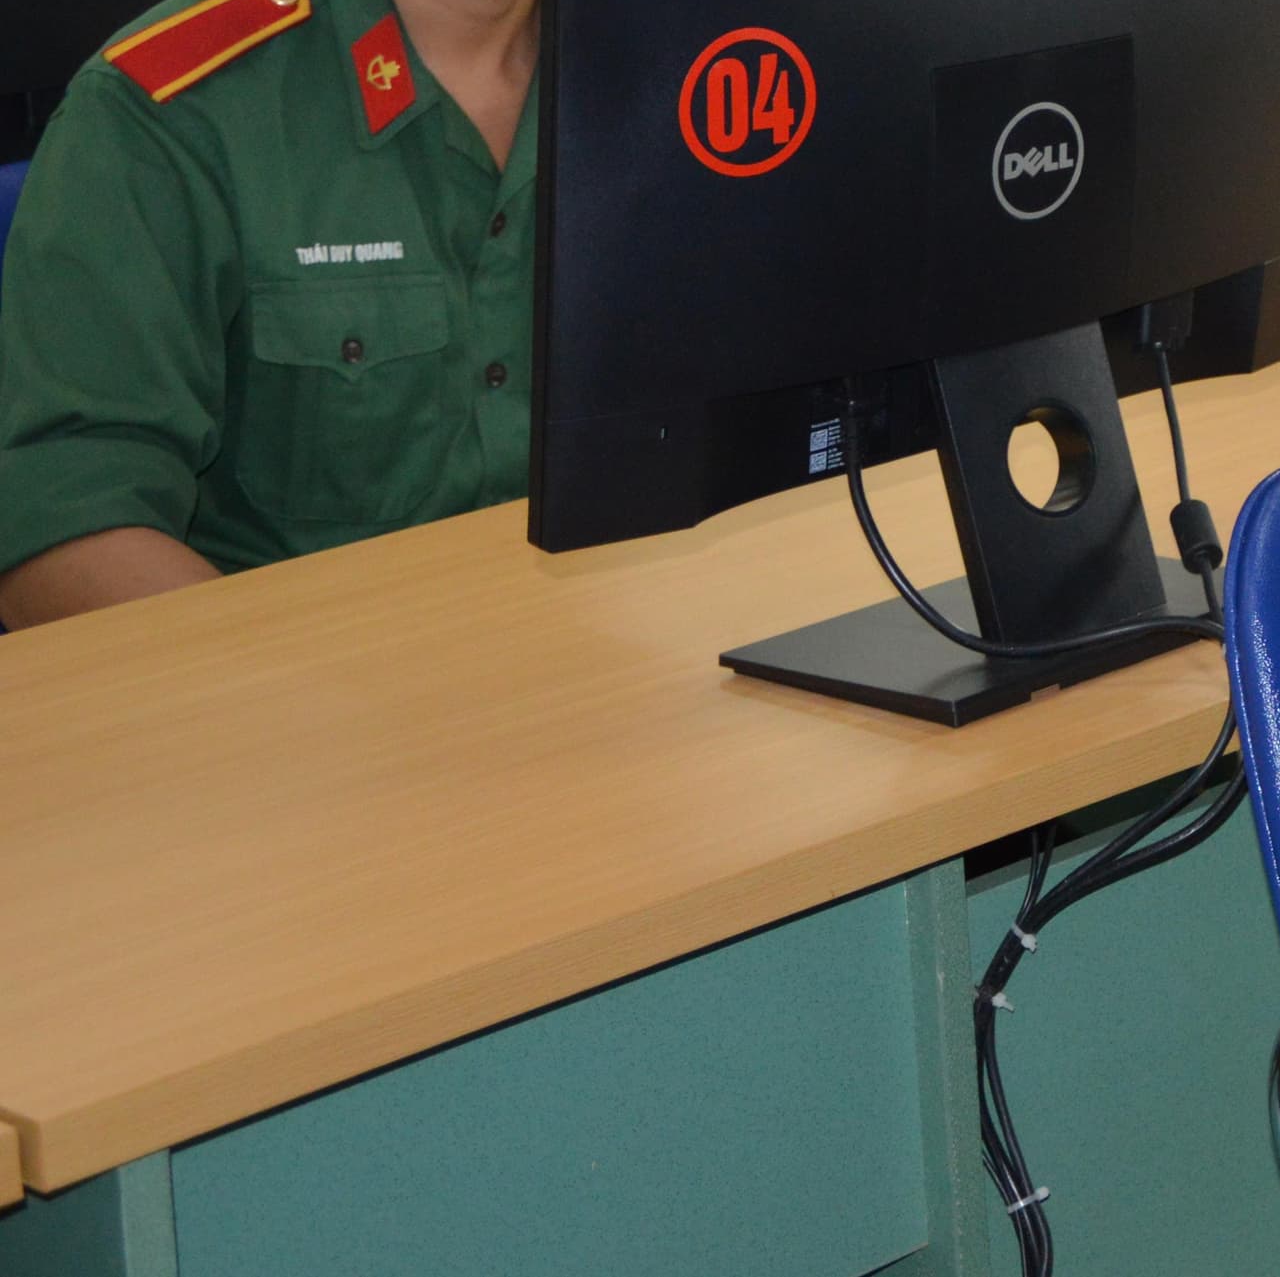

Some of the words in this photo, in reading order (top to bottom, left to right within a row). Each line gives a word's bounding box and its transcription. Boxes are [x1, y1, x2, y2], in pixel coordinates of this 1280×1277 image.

[706, 52, 795, 153] 04
[1003, 142, 1075, 181] DELL
[295, 242, 328, 265] THÁI
[355, 241, 404, 264] QUANG
